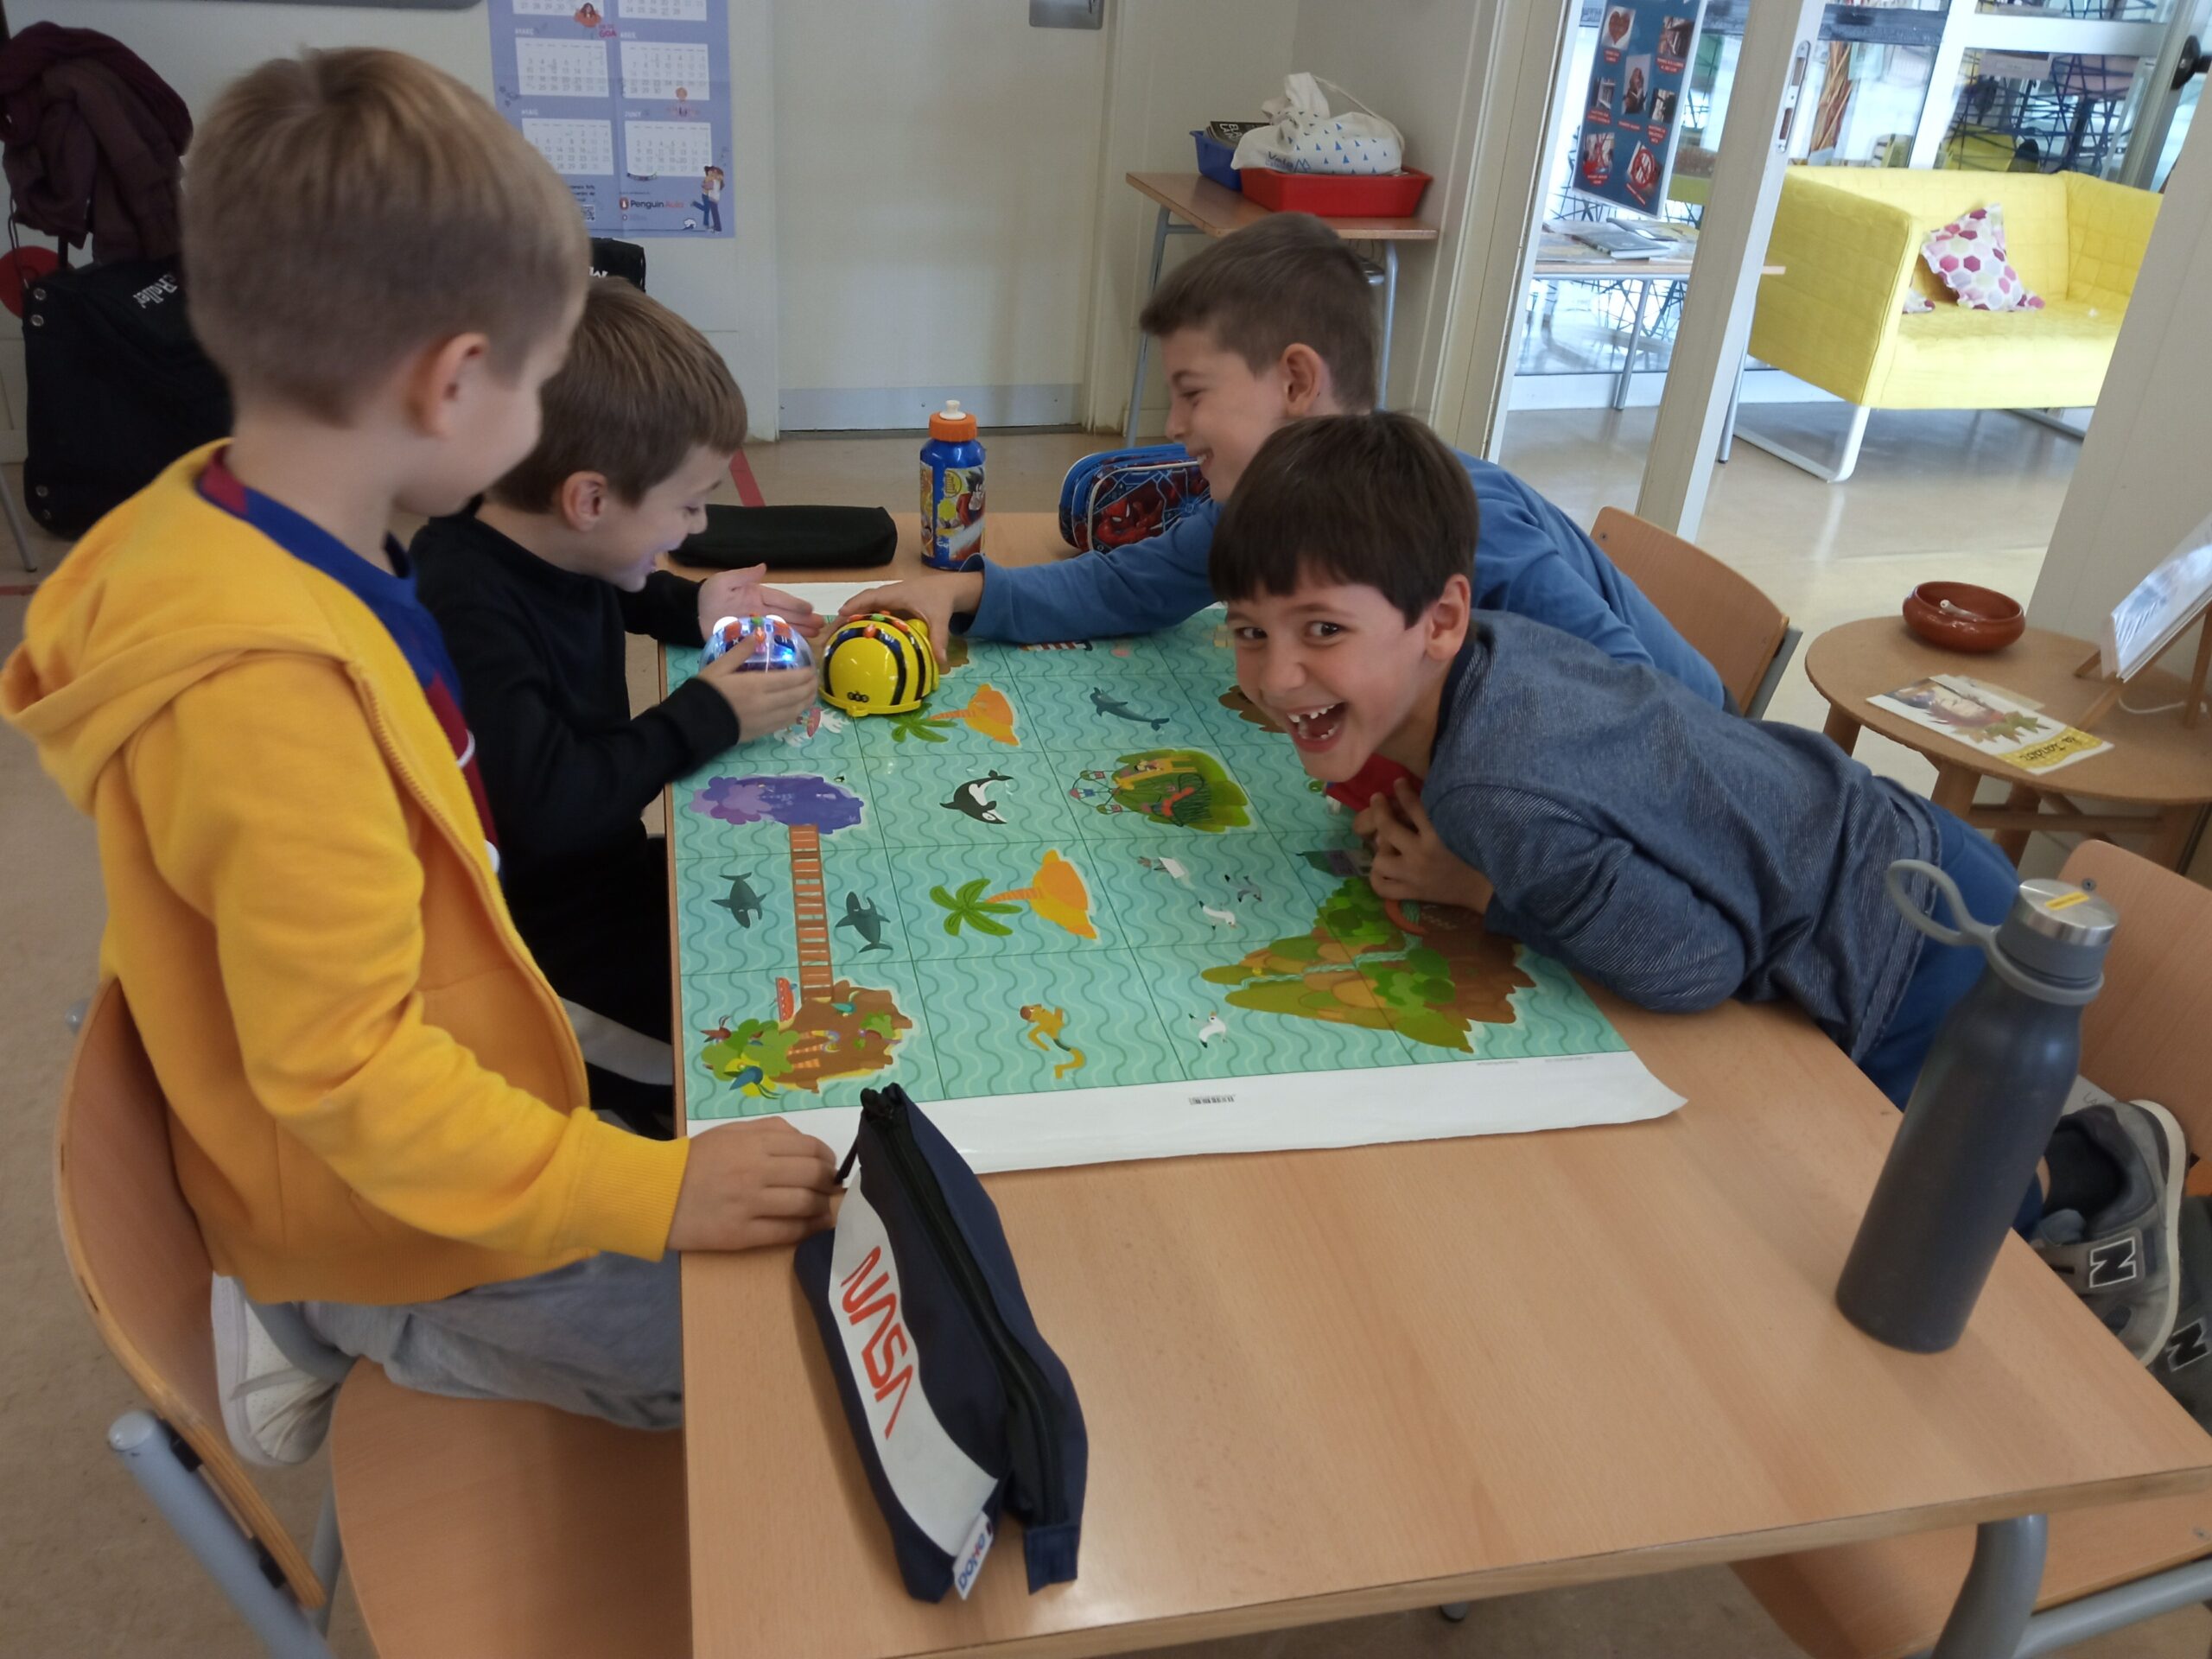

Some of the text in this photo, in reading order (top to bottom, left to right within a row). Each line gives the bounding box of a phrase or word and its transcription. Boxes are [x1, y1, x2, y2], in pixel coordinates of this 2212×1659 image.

[630, 200, 664, 209] Penguin
[2089, 1236, 2137, 1288] N
[840, 1246, 913, 1440] NASA
